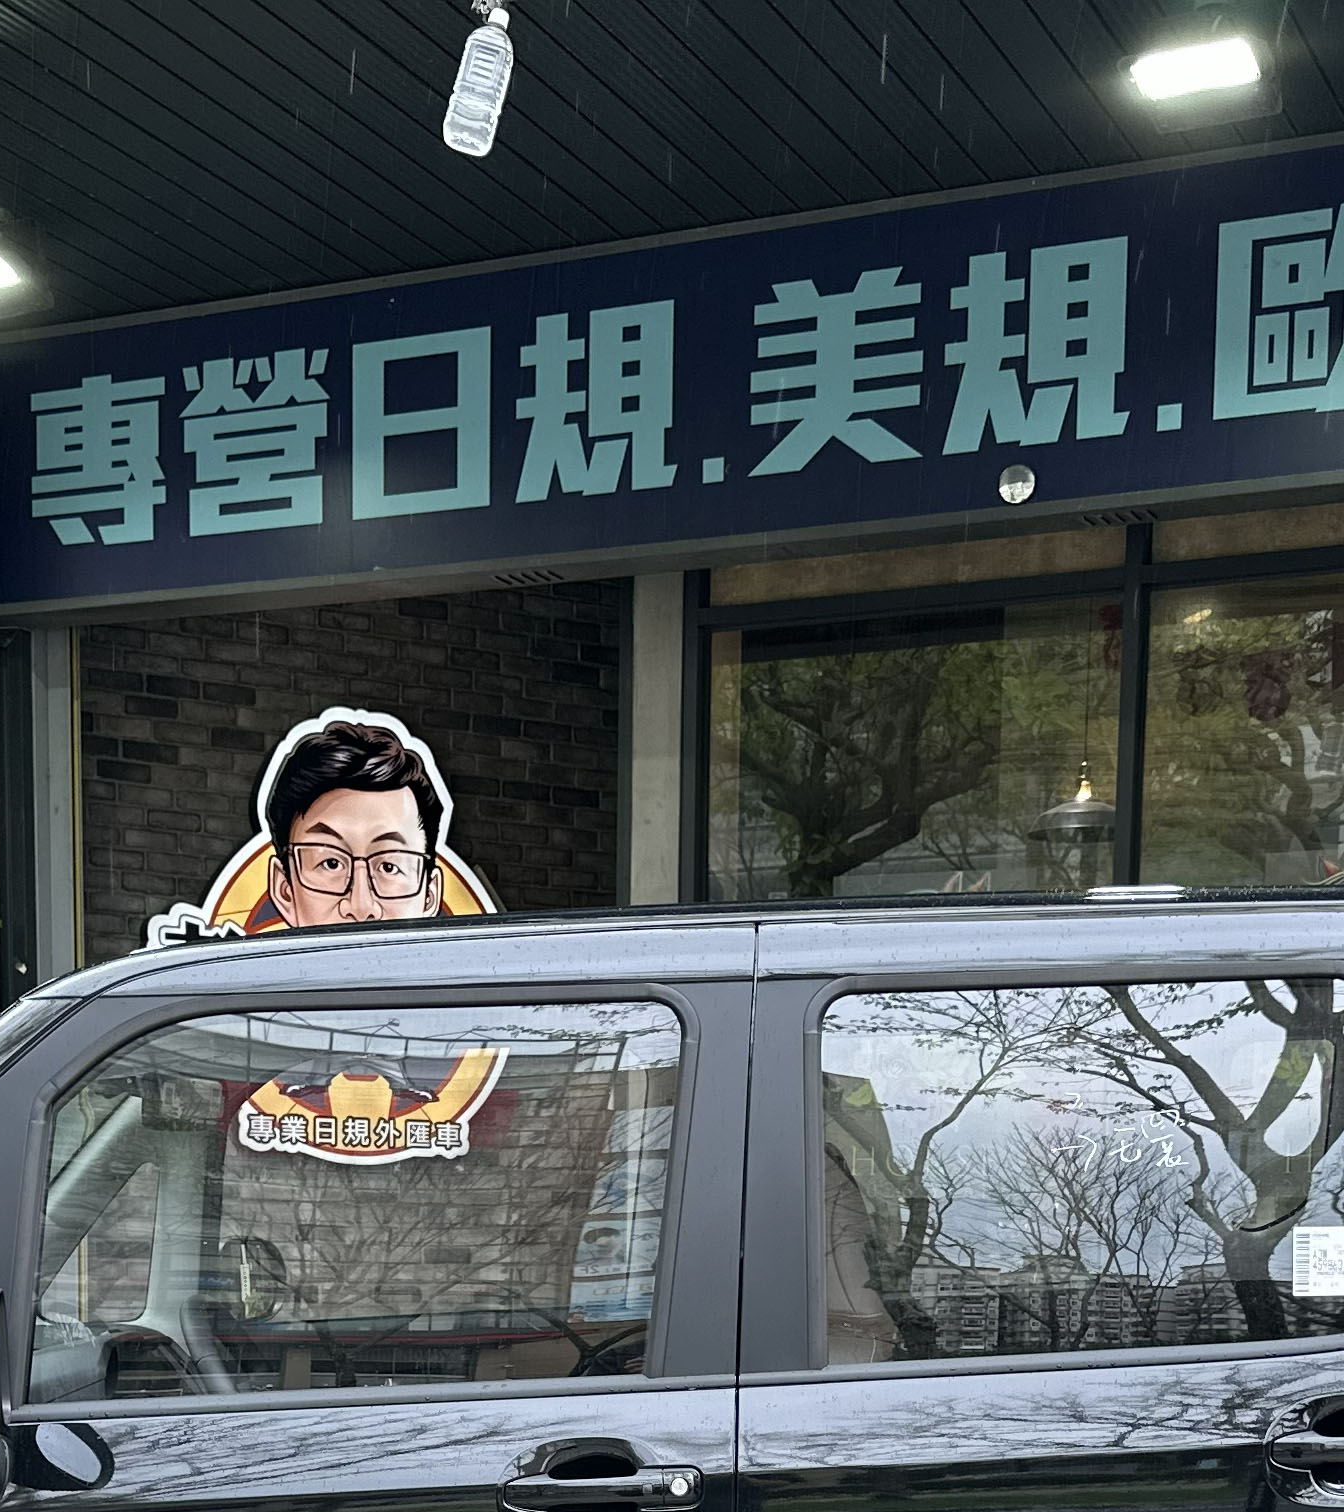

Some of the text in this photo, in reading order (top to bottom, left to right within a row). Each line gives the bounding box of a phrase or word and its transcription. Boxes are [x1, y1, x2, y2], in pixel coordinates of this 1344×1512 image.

[248, 1113, 462, 1149] 專業日規外匯車
